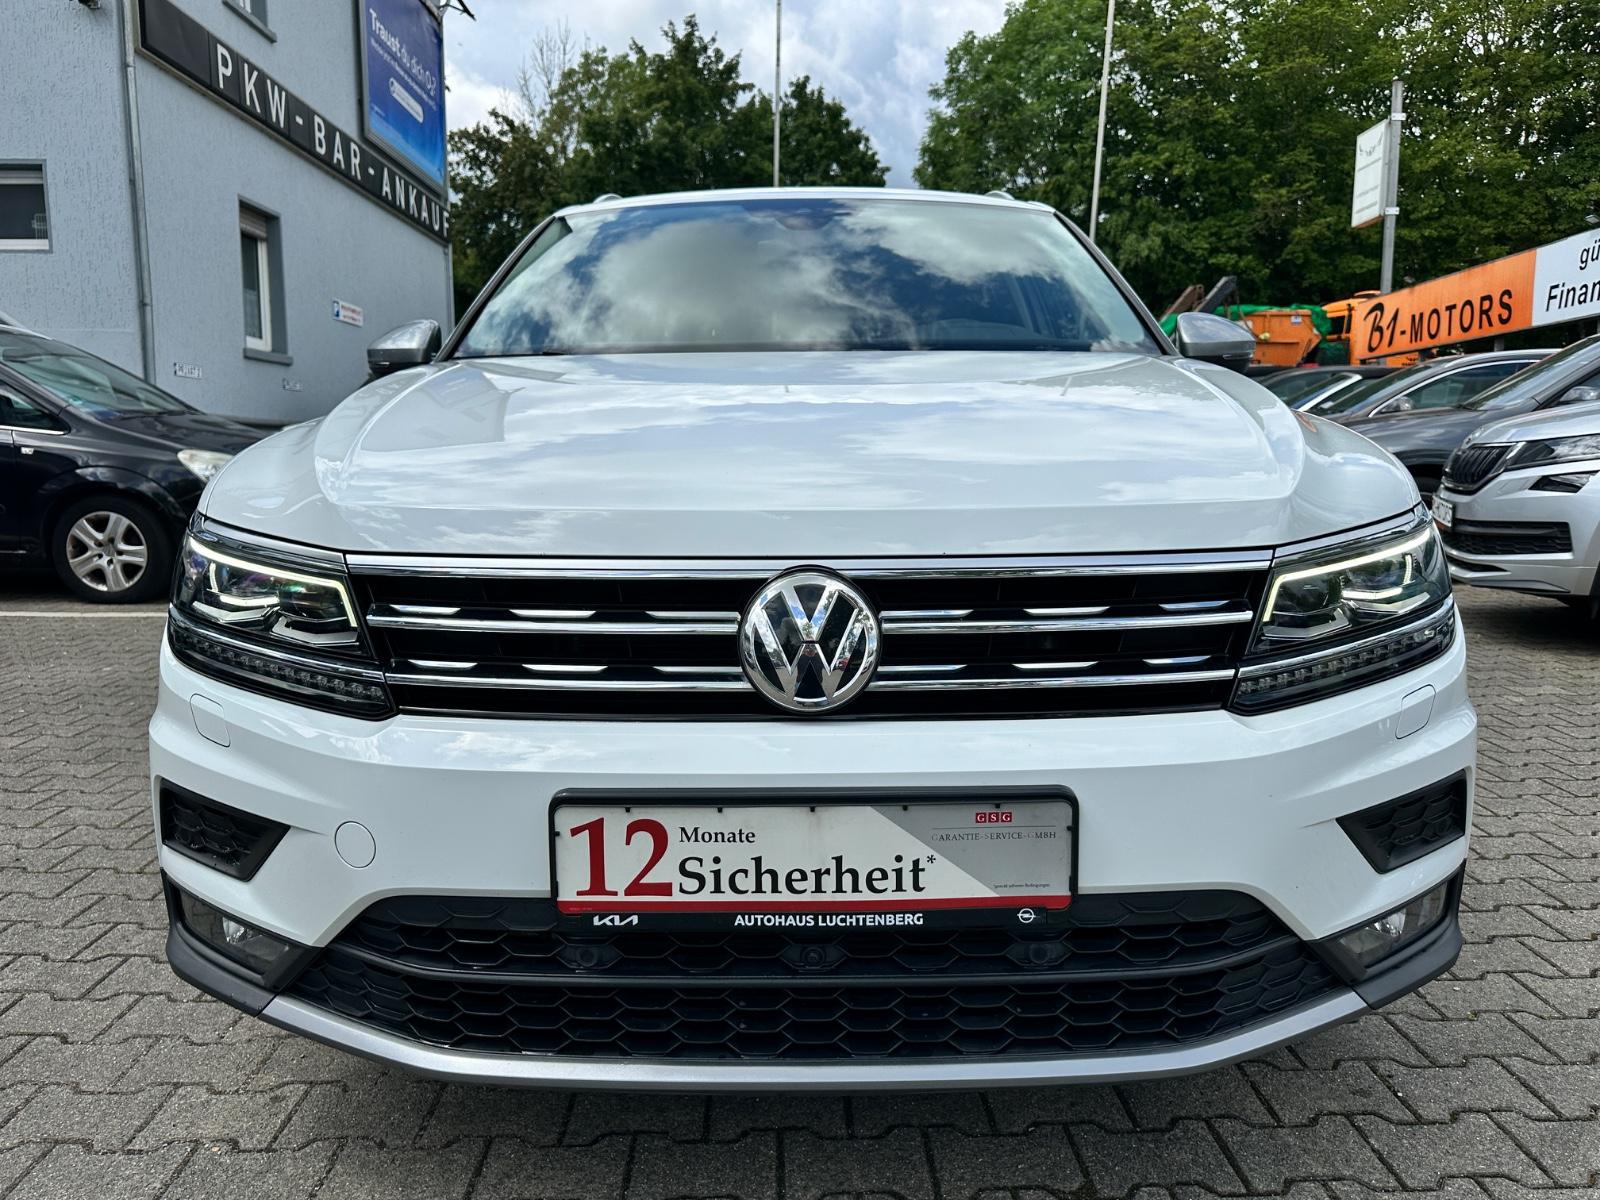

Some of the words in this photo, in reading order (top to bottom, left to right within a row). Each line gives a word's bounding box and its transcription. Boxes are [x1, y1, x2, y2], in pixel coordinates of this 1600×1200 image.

[369, 8, 400, 57] Traust
[216, 43, 450, 238] PKW-BAR-ANKAUF
[1363, 289, 1513, 353] B1-MOTORS
[1546, 281, 1600, 312] Finan
[976, 812, 1012, 823] GSG
[569, 817, 673, 896] 12
[679, 826, 756, 843] Monate
[734, 914, 815, 926] AUTOHAUS
[818, 913, 924, 926] LUCHTENBERG
